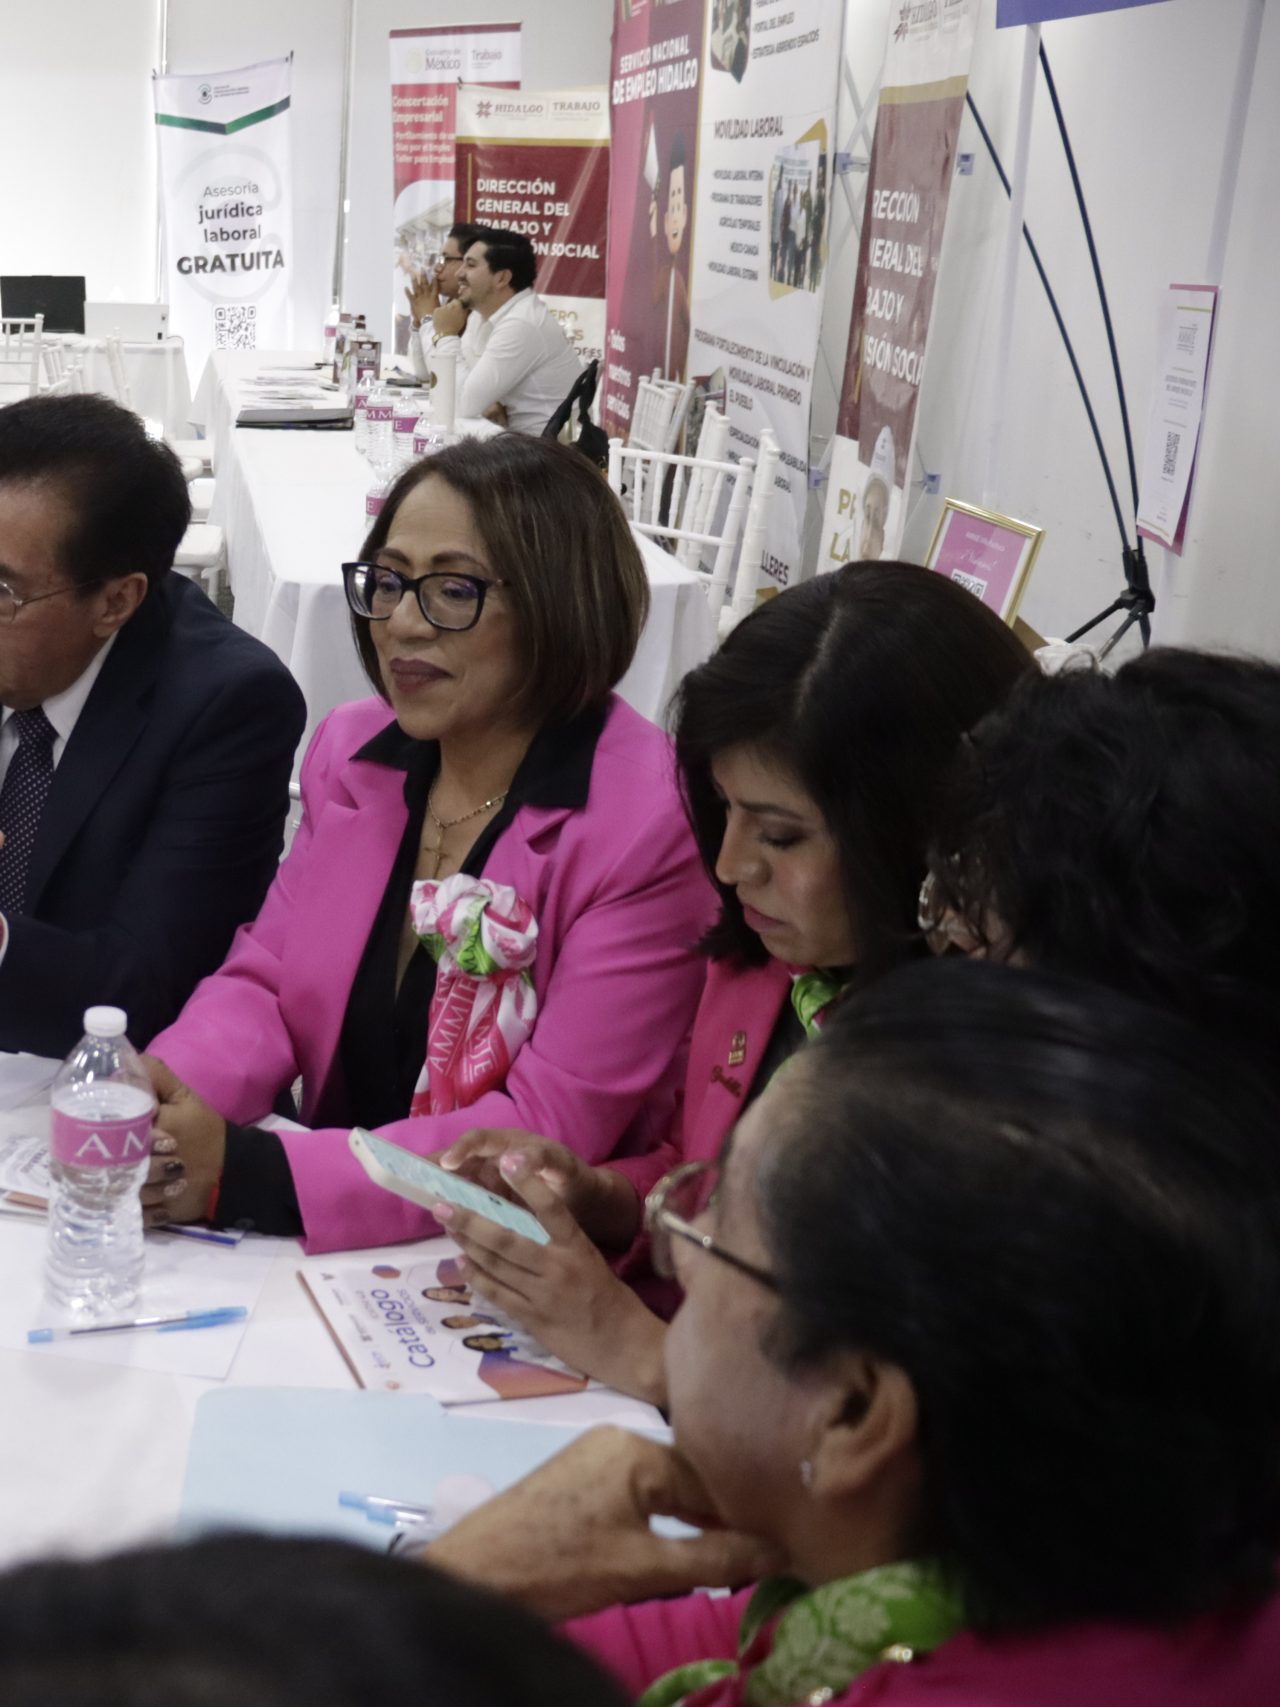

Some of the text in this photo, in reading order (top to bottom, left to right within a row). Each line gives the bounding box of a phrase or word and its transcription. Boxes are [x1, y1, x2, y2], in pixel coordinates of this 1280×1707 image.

[425, 57, 461, 71] México
[471, 49, 502, 61] Trabajo
[620, 34, 689, 75] SERVICIO NACIONAL
[612, 58, 698, 105] DE EMPLEO HIDALGO
[494, 103, 544, 114] HIDALGO
[552, 101, 601, 113] TRABAJO
[750, 116, 783, 138] LABORAL
[203, 181, 259, 198] Asesoría
[477, 177, 556, 195] DIRECCIÓN
[198, 202, 263, 224] jurídica
[476, 198, 570, 217] GENERAL DEL
[873, 184, 919, 224] RECCIÓN
[203, 224, 261, 243] laboral
[542, 222, 553, 236] Y
[551, 243, 600, 259] SOCIAL
[177, 249, 285, 275] GRATUITA
[893, 346, 924, 386] SOCIA
[760, 550, 789, 586] LLERES
[371, 1288, 435, 1369] Catálogo
